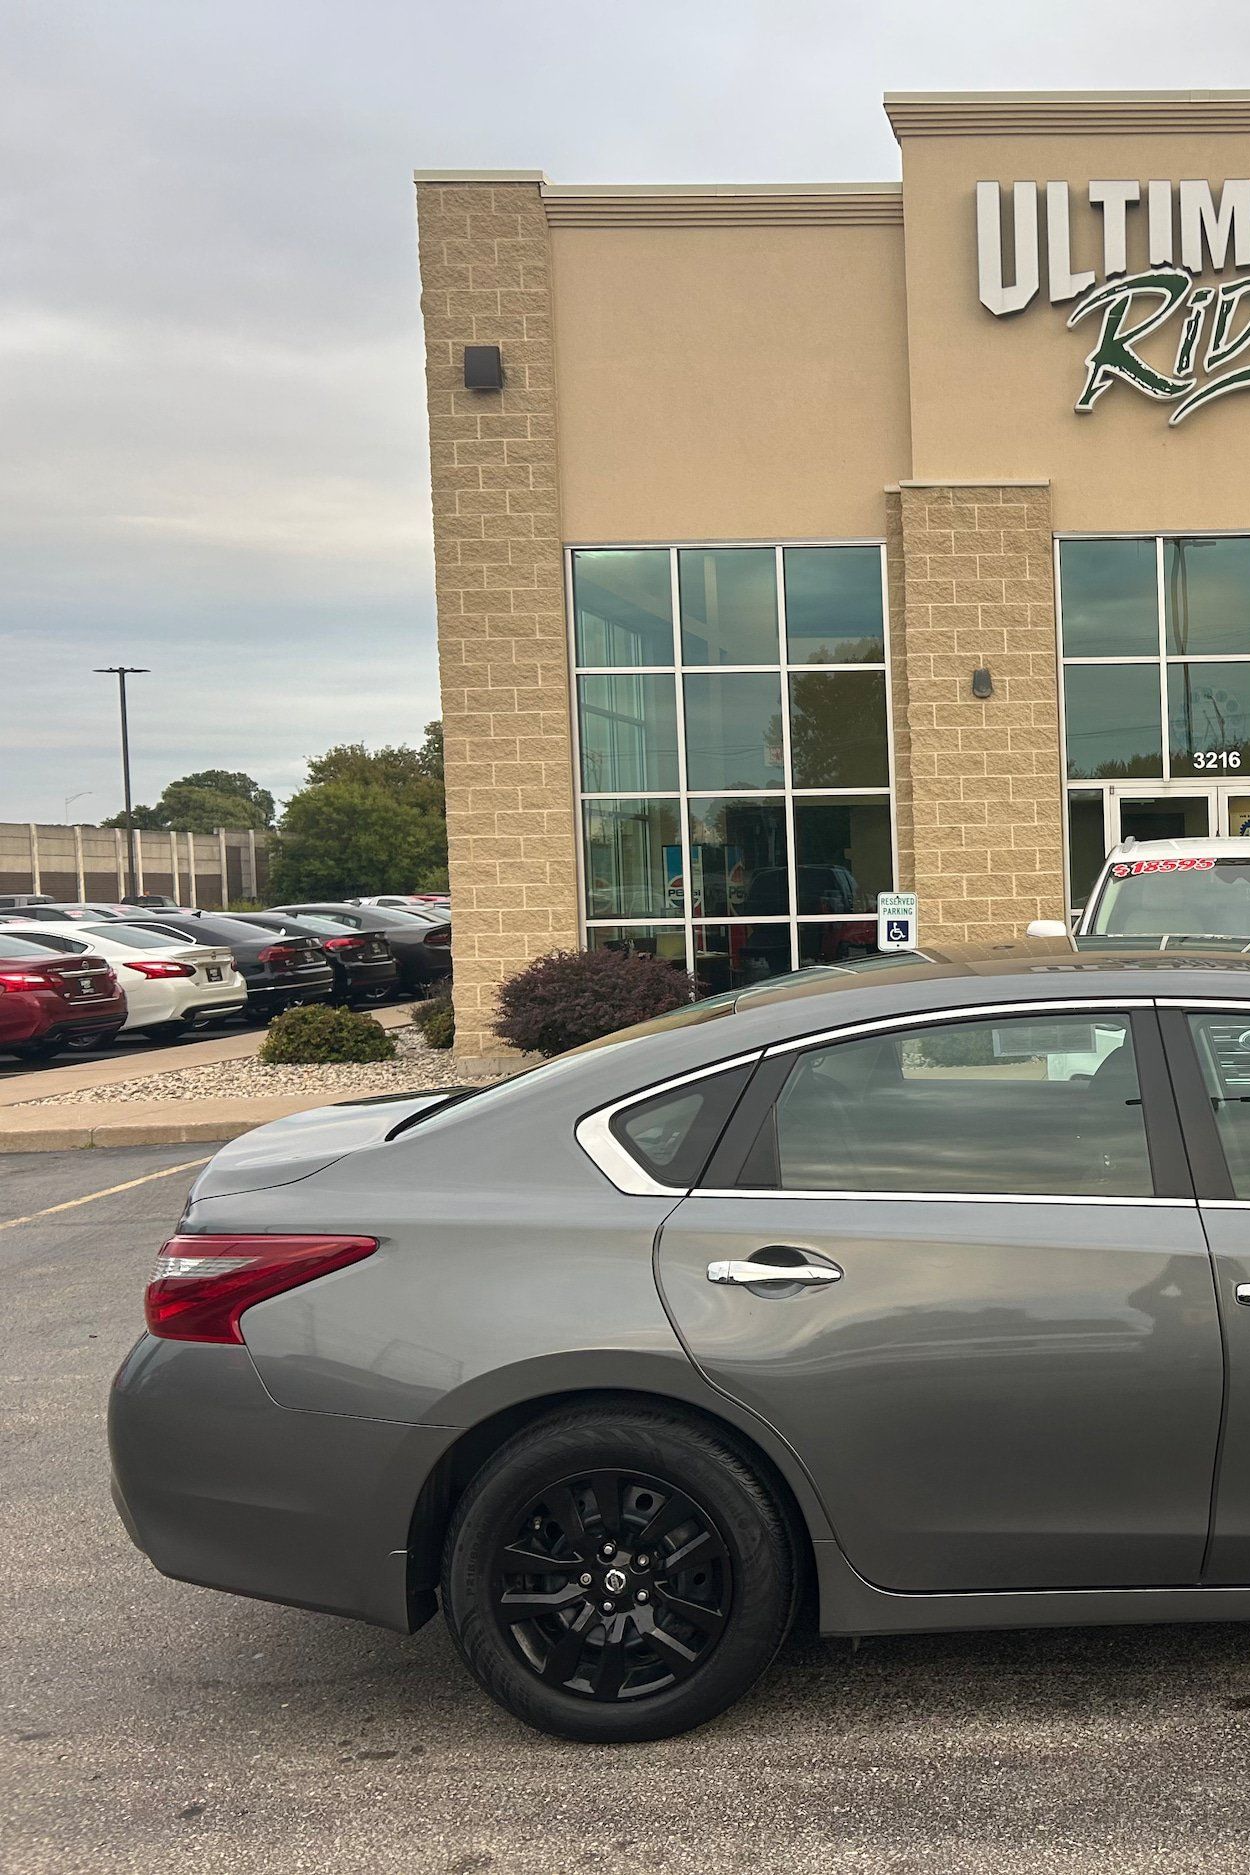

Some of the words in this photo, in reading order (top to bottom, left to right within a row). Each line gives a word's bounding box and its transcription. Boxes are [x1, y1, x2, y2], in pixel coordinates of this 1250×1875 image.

[1193, 751, 1241, 769] 3216
[1112, 858, 1217, 877] $18595
[668, 889, 701, 897] PESI
[881, 897, 915, 906] RESERVED
[883, 907, 913, 915] PARKING
